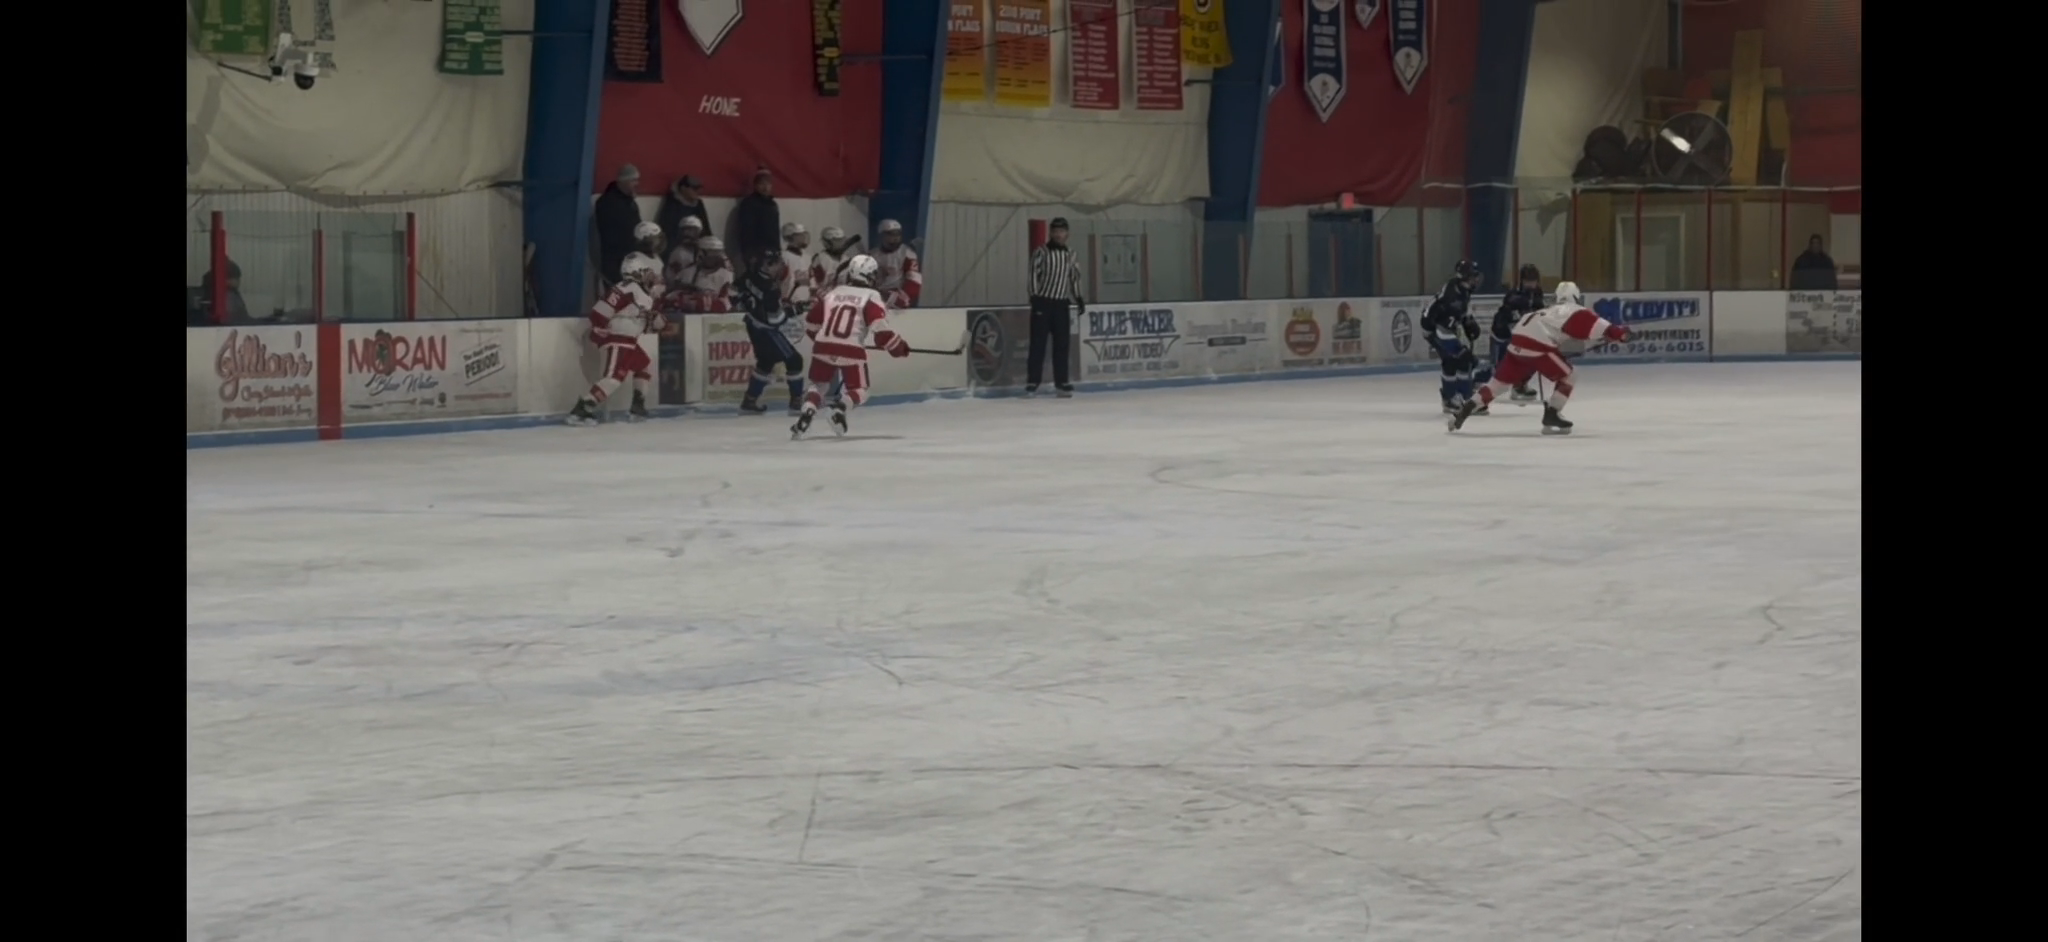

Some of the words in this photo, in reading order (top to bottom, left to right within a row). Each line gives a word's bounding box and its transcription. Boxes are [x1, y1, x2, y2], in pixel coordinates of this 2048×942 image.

[826, 304, 857, 339] 10
[1090, 311, 1127, 336] BLUE
[1128, 308, 1177, 334] WATER
[347, 334, 446, 375] MORAN
[708, 340, 752, 361] HAPP
